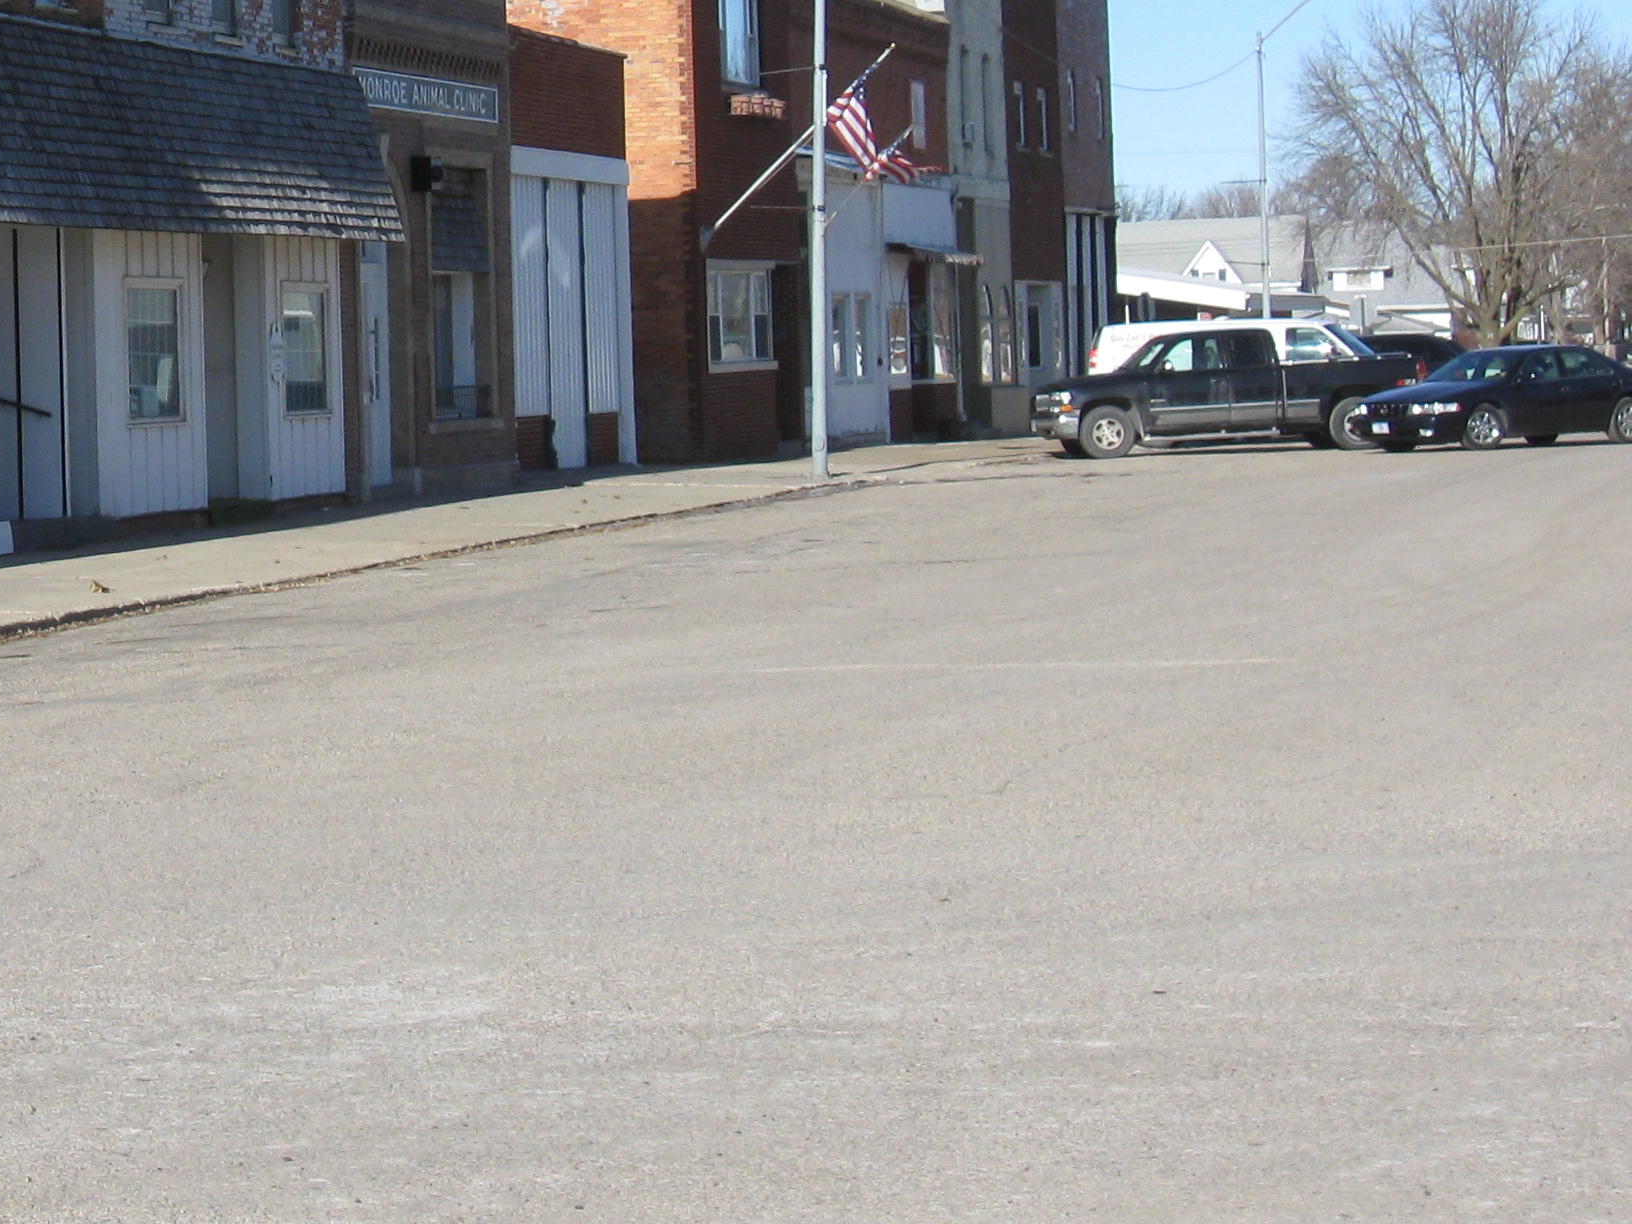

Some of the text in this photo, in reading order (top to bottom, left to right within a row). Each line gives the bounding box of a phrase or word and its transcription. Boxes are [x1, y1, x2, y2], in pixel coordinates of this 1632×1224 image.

[358, 76, 487, 115] MONROE ANIMAL CLINIC
